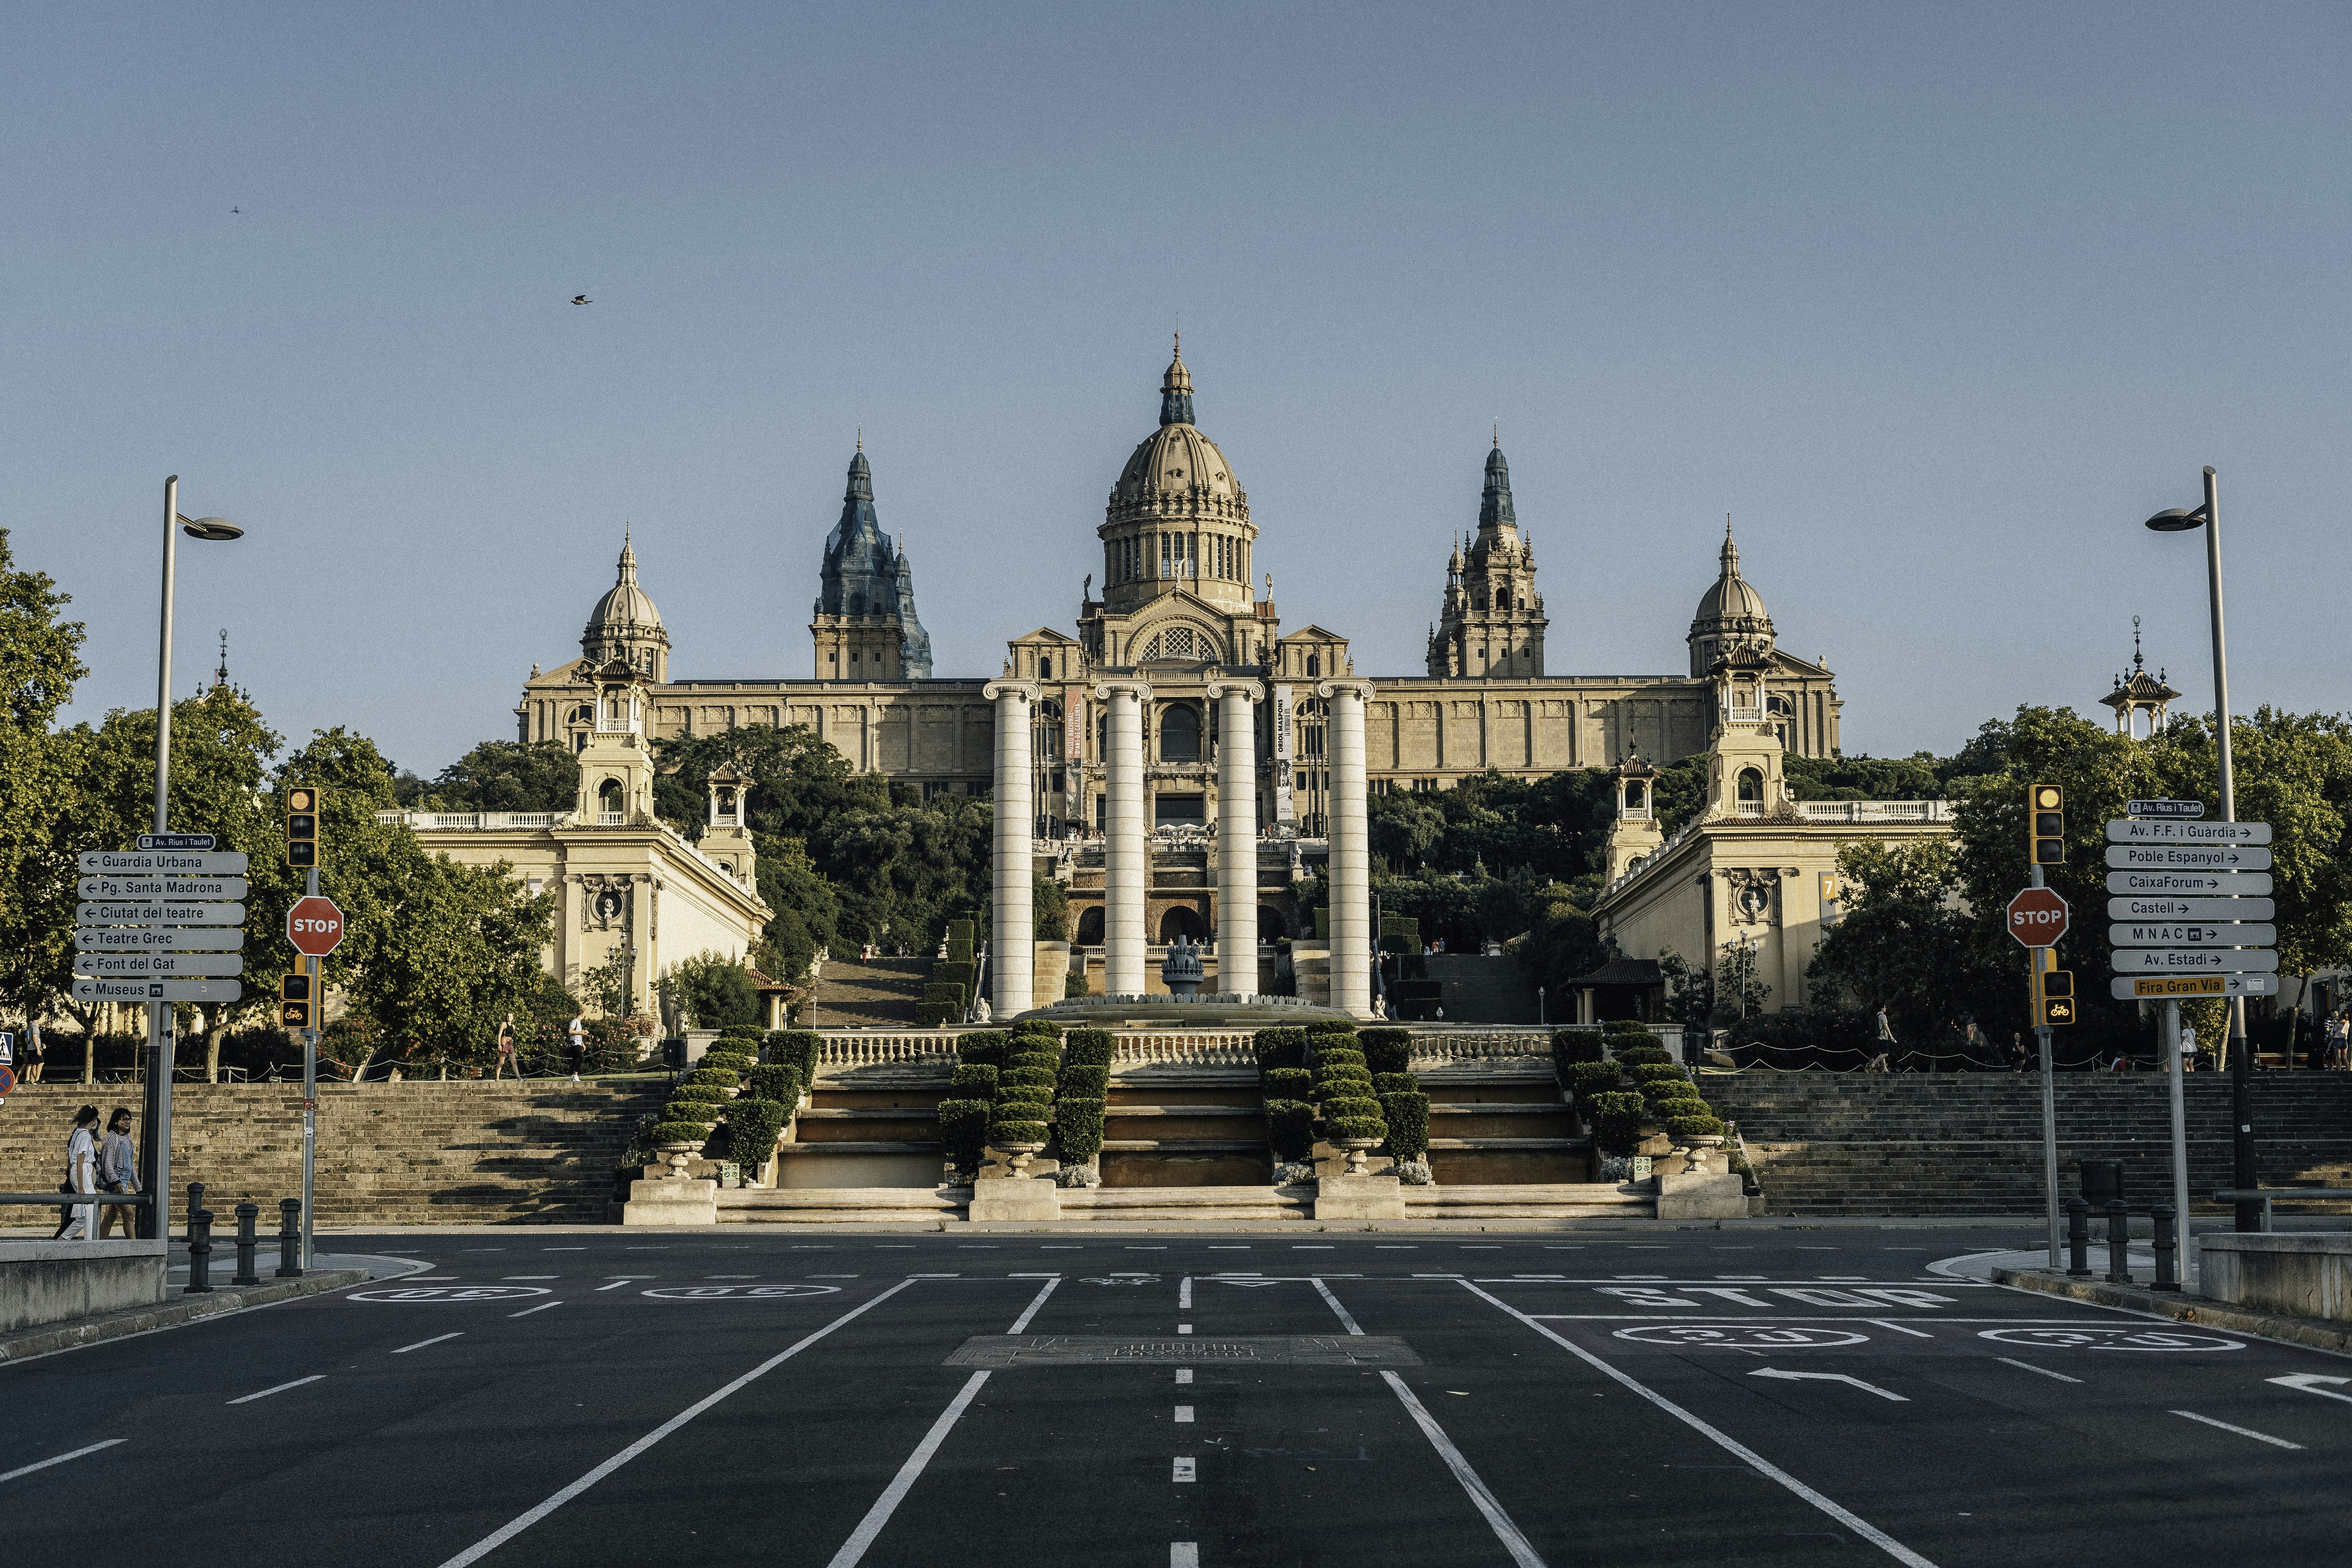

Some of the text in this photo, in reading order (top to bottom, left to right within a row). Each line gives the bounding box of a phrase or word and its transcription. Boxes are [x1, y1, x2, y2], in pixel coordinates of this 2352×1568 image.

[2178, 803, 2201, 811] Taulet
[2130, 825, 2236, 837] Av. F.F. i Guàrdia
[103, 855, 201, 867] Guardia Urbana
[2129, 851, 2223, 865] Poble Espanyol
[1824, 880, 1833, 895] 7
[2129, 876, 2203, 887] CaixaForum
[102, 882, 221, 895] Pg. Santa Madrona
[101, 907, 203, 918] Ciutat del teatre
[2131, 902, 2173, 913] Castell
[2014, 910, 2061, 924] STOP
[294, 919, 338, 933] STOP
[98, 933, 172, 944] Teatre Grec
[98, 958, 174, 969] Font del Gat
[2145, 954, 2206, 965] Av. Estadi
[96, 983, 144, 995] Museus
[2139, 979, 2220, 993] Fira Gran Via
[1592, 1287, 1958, 1308] STOP
[1669, 1329, 1814, 1341] 30
